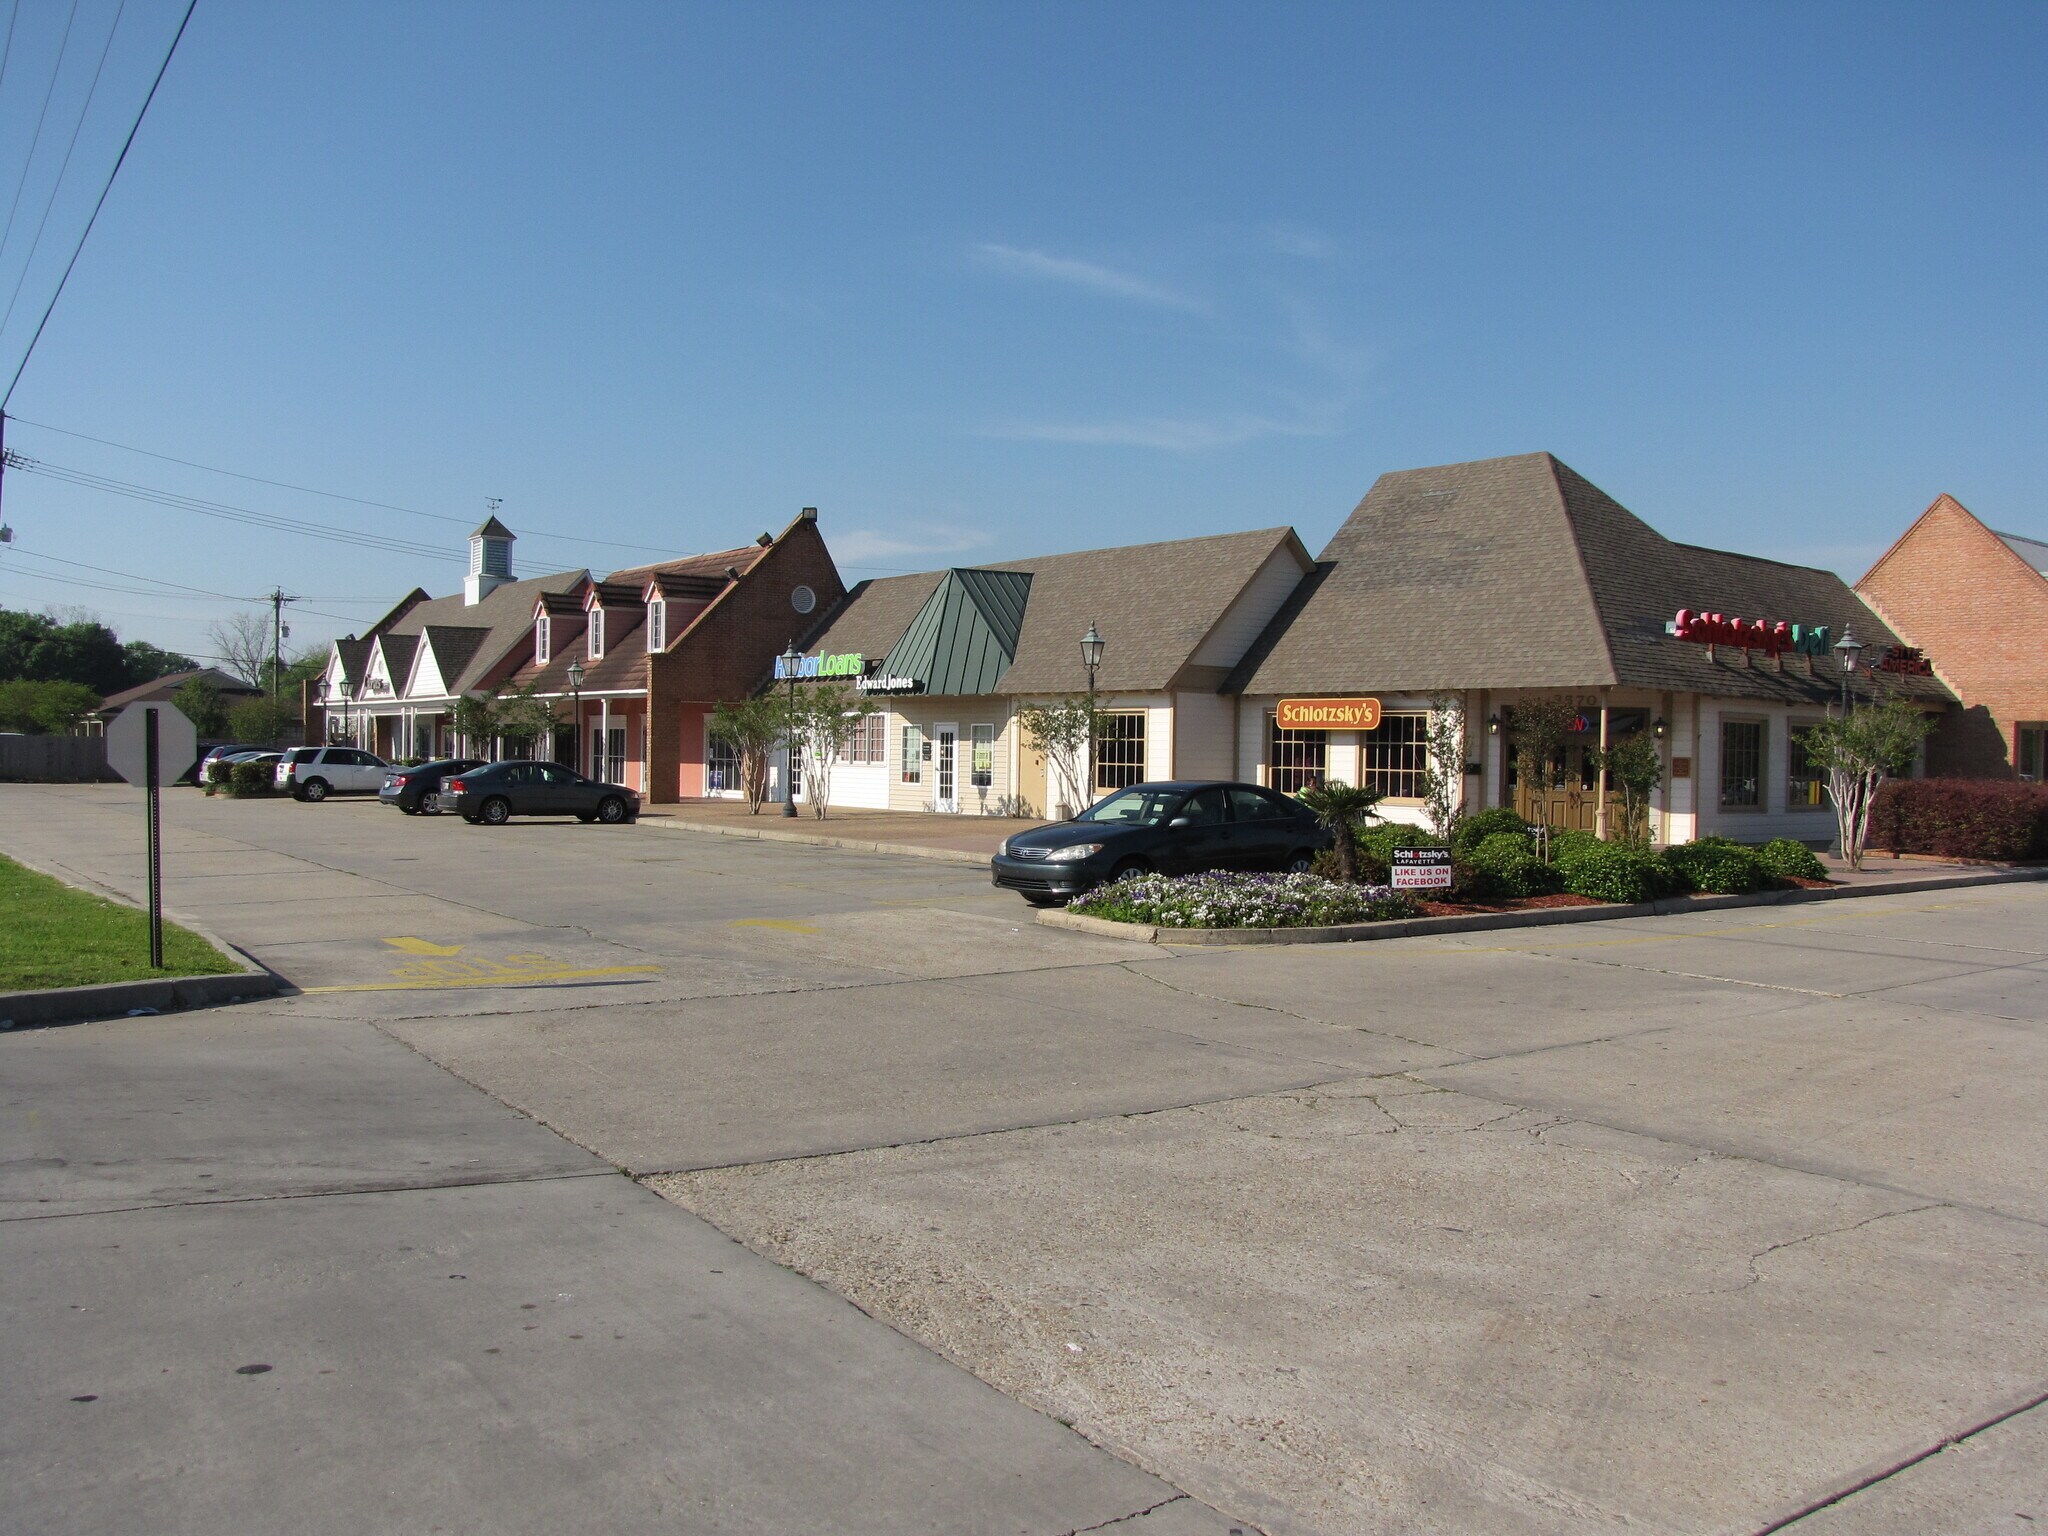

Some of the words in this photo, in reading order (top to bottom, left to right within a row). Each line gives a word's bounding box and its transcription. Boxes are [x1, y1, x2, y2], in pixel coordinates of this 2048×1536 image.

[1283, 703, 1373, 724] Schlotzsky's
[1393, 850, 1448, 859] Schlotzsky's
[1394, 868, 1416, 876] LIKE
[1419, 868, 1432, 876] US
[1396, 877, 1447, 885] FACEBOOK
[388, 954, 572, 979] STOP
